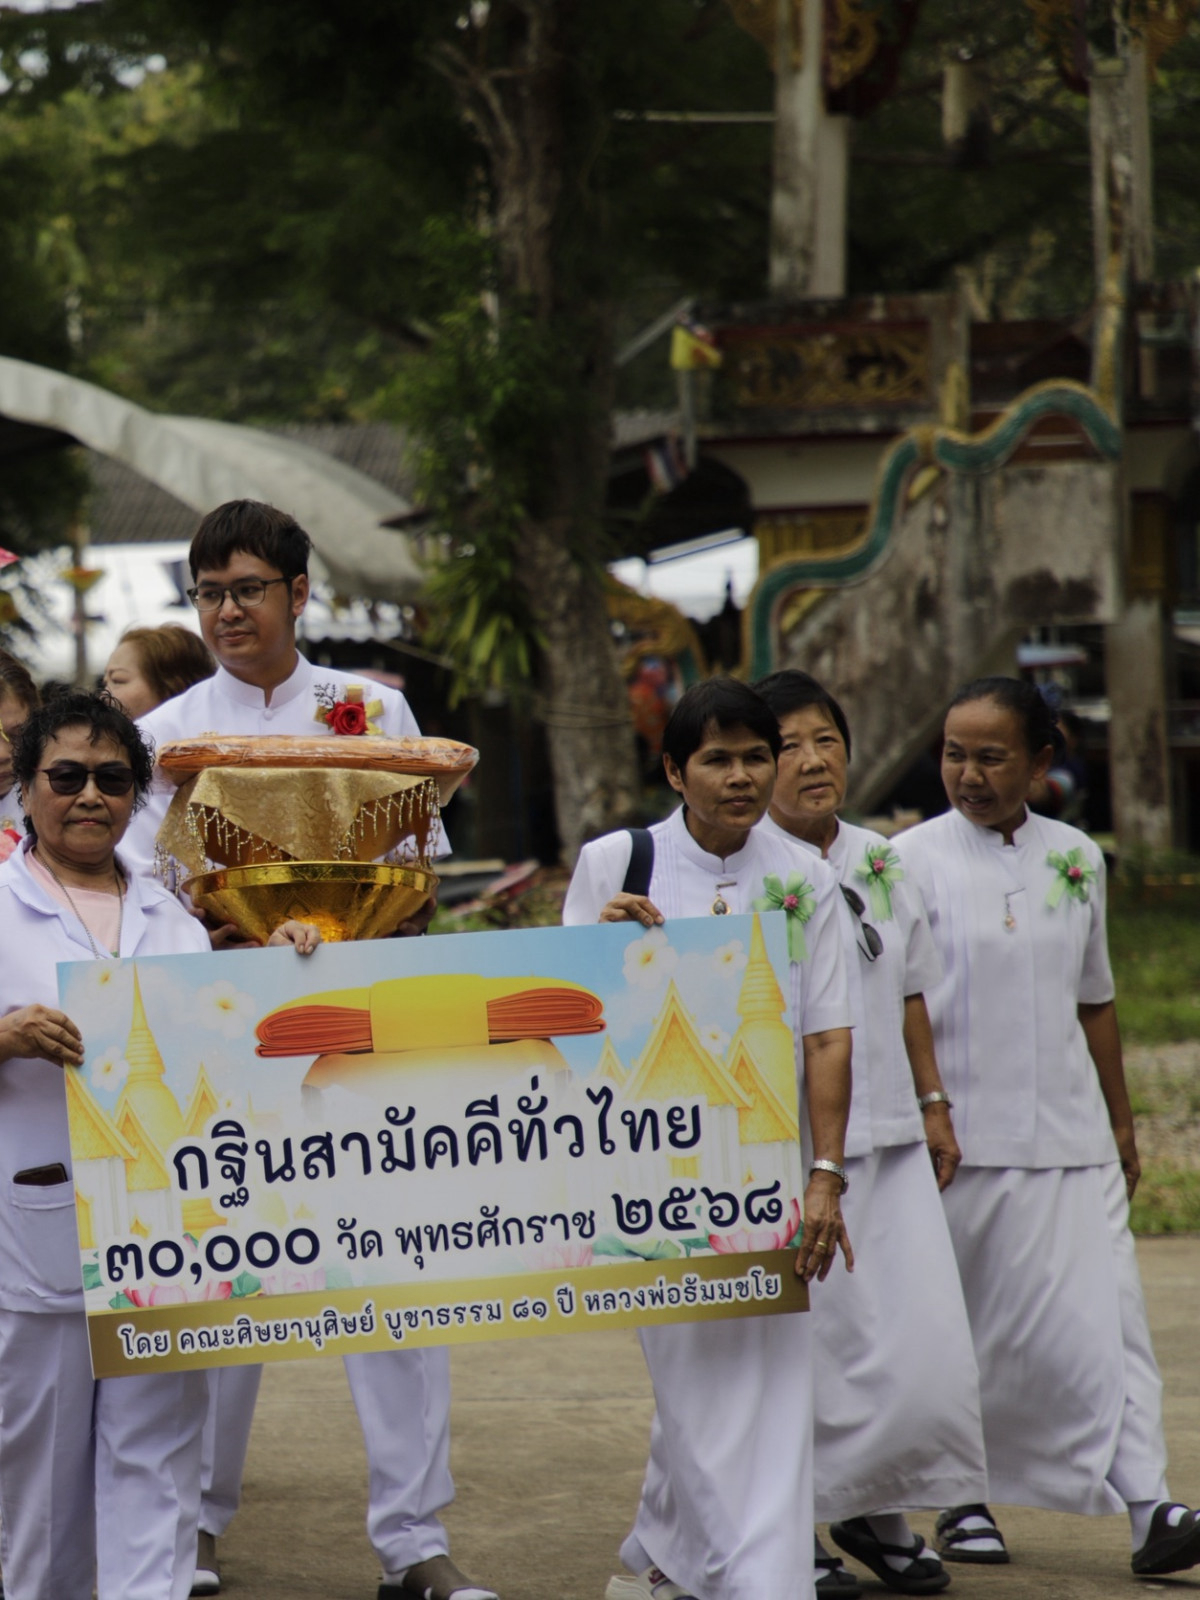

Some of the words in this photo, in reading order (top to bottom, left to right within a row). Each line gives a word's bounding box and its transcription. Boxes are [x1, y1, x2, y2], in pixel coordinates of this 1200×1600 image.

[174, 1075, 701, 1208] กฐินสามัคคีทั่วไทย
[106, 1227, 320, 1285] ๓๐,๐๐๐
[337, 1217, 383, 1260] วัด
[395, 1205, 595, 1270] พุทธศักราช
[611, 1179, 783, 1235] ๒๕๖๘
[121, 1328, 169, 1356] โดย
[180, 1303, 374, 1348] คณะศิษยานุศิษย์
[385, 1300, 502, 1340] บูชาธรรม
[512, 1299, 548, 1319] ๘๑
[557, 1286, 574, 1314] ปี
[585, 1269, 780, 1312] หลวงพ่อธัมมชโย
